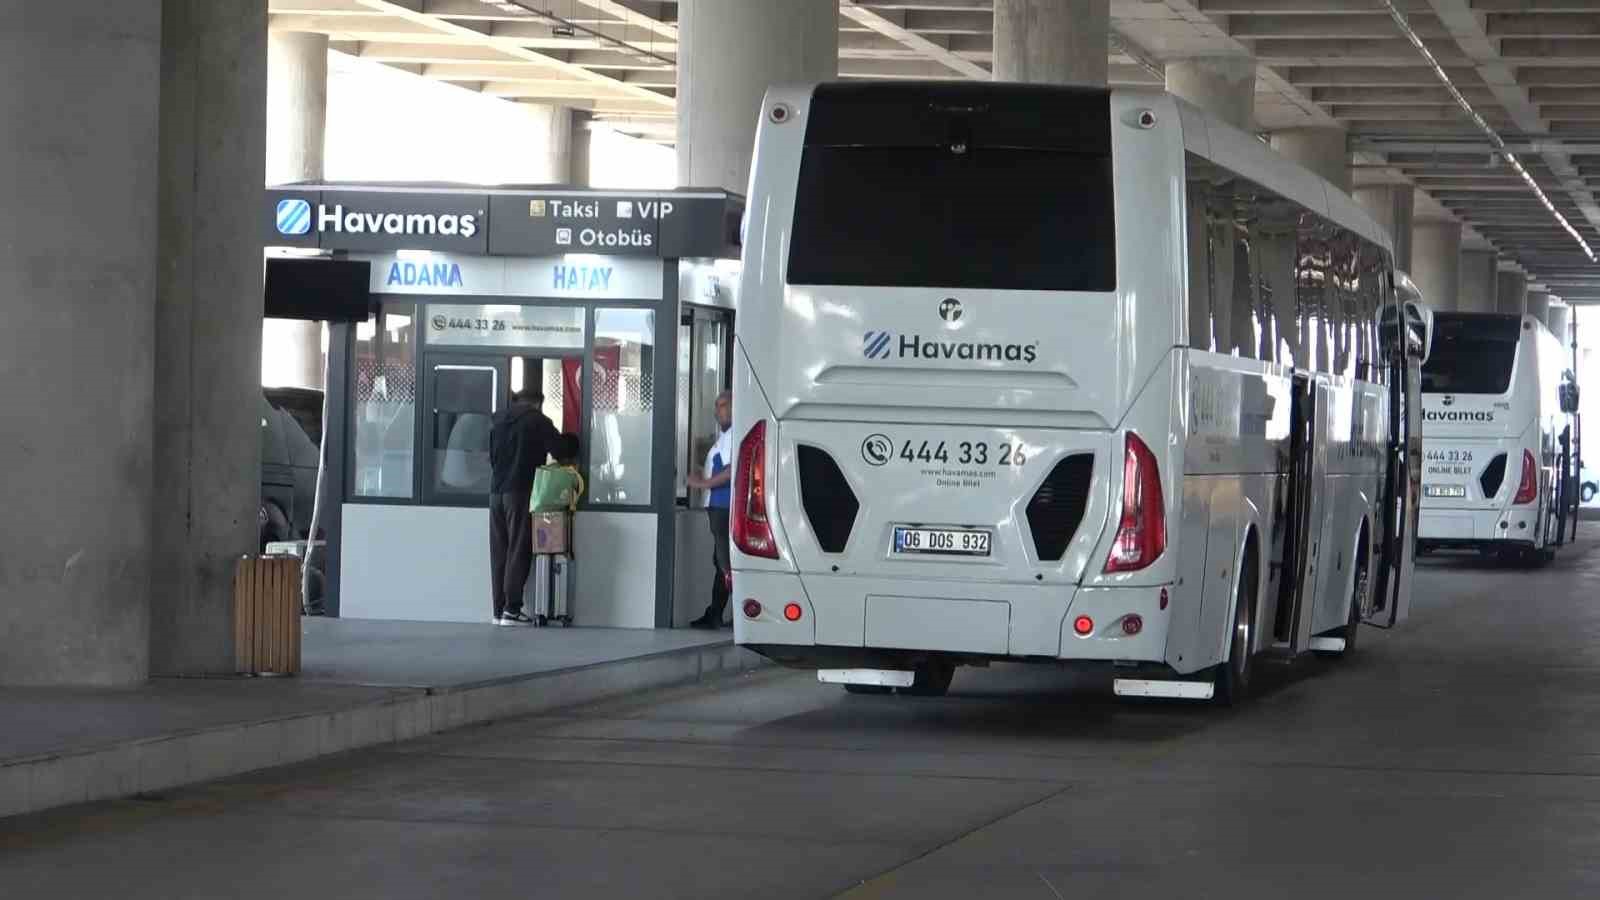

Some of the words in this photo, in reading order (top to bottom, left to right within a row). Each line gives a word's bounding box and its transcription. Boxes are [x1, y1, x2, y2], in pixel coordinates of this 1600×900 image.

[318, 204, 476, 237] Havamaş
[550, 200, 600, 218] Taksi
[637, 201, 673, 219] VIP
[579, 228, 652, 247] Otobüs
[387, 262, 464, 287] ADANA
[553, 265, 613, 290] HATAY
[448, 318, 471, 330] 444
[474, 319, 488, 331] 33
[492, 320, 505, 331] 26
[899, 334, 1037, 363] Havamaş
[900, 440, 949, 463] 444
[958, 442, 988, 464] 33
[998, 443, 1026, 466] 26
[1427, 451, 1445, 461] 444
[904, 531, 920, 547] 06
[929, 532, 953, 549] DOS
[962, 534, 987, 550] 932
